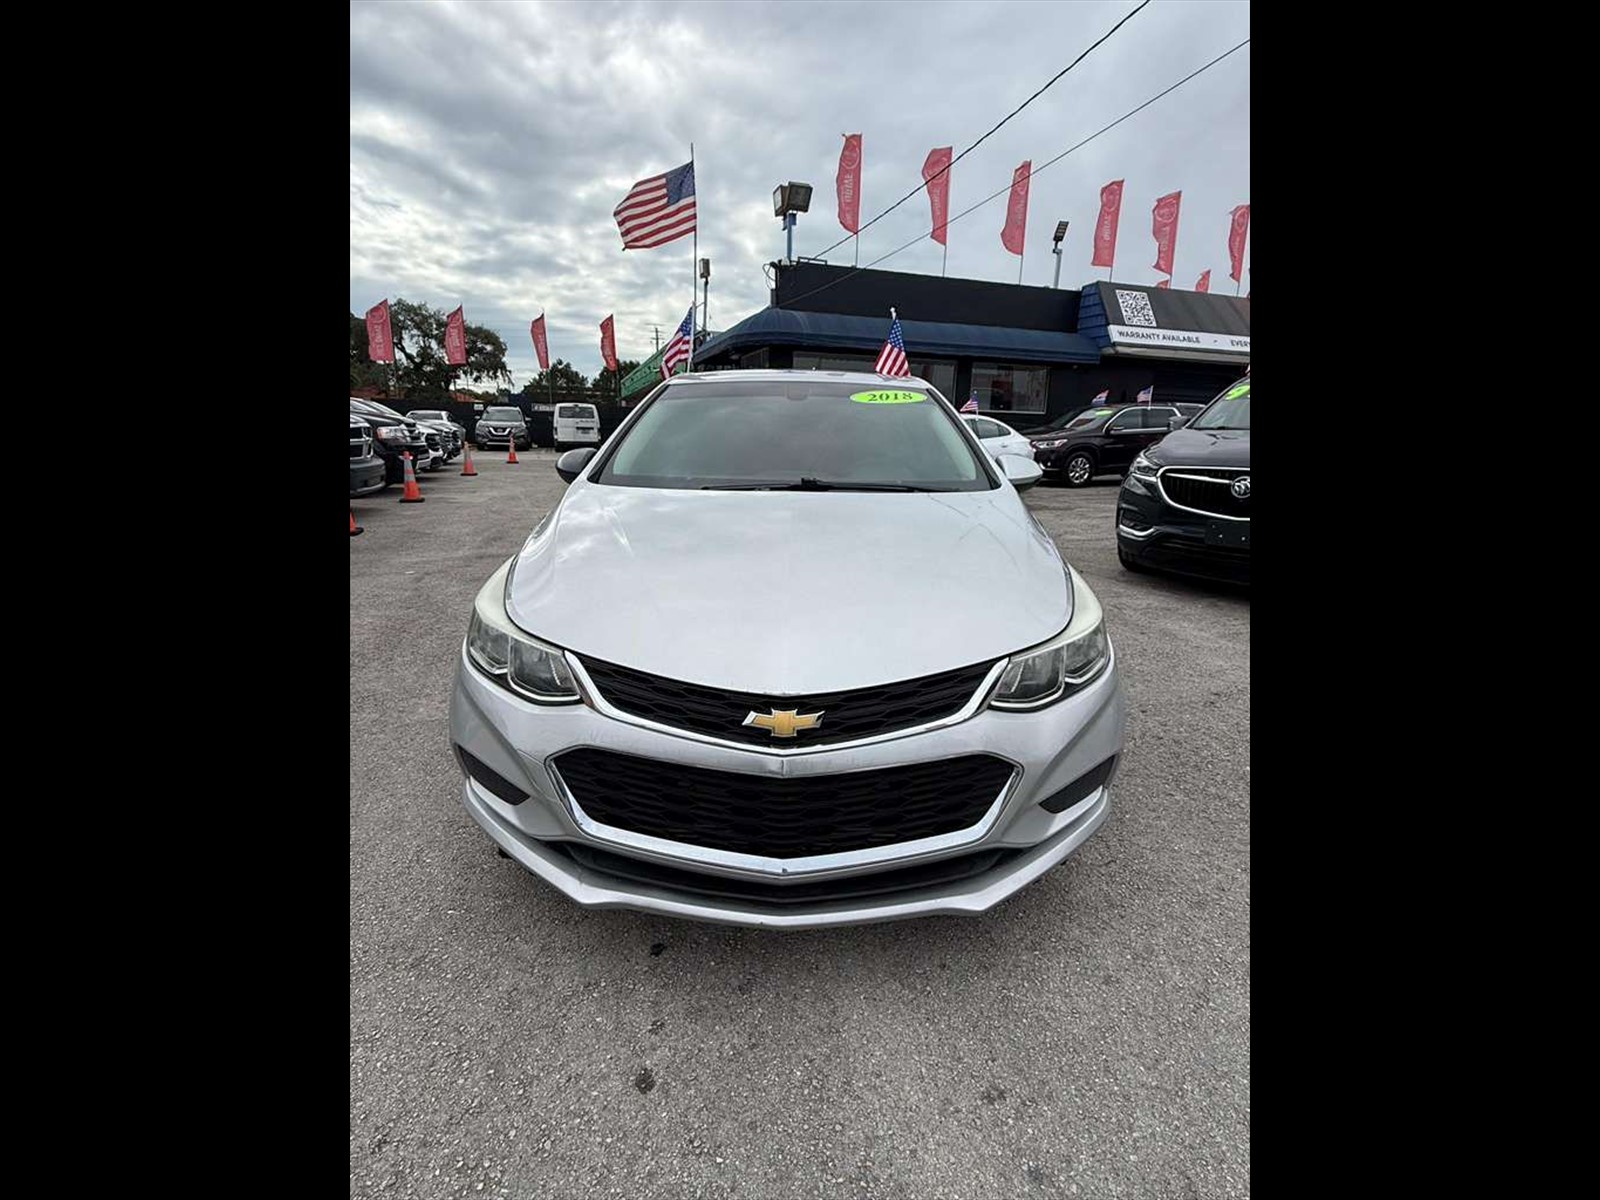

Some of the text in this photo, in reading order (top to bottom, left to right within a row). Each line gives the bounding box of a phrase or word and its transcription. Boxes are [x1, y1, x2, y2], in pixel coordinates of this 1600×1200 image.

[1117, 330, 1160, 341] WARRANTY
[1162, 334, 1201, 344] AVAILABLE
[867, 392, 913, 402] 2018
